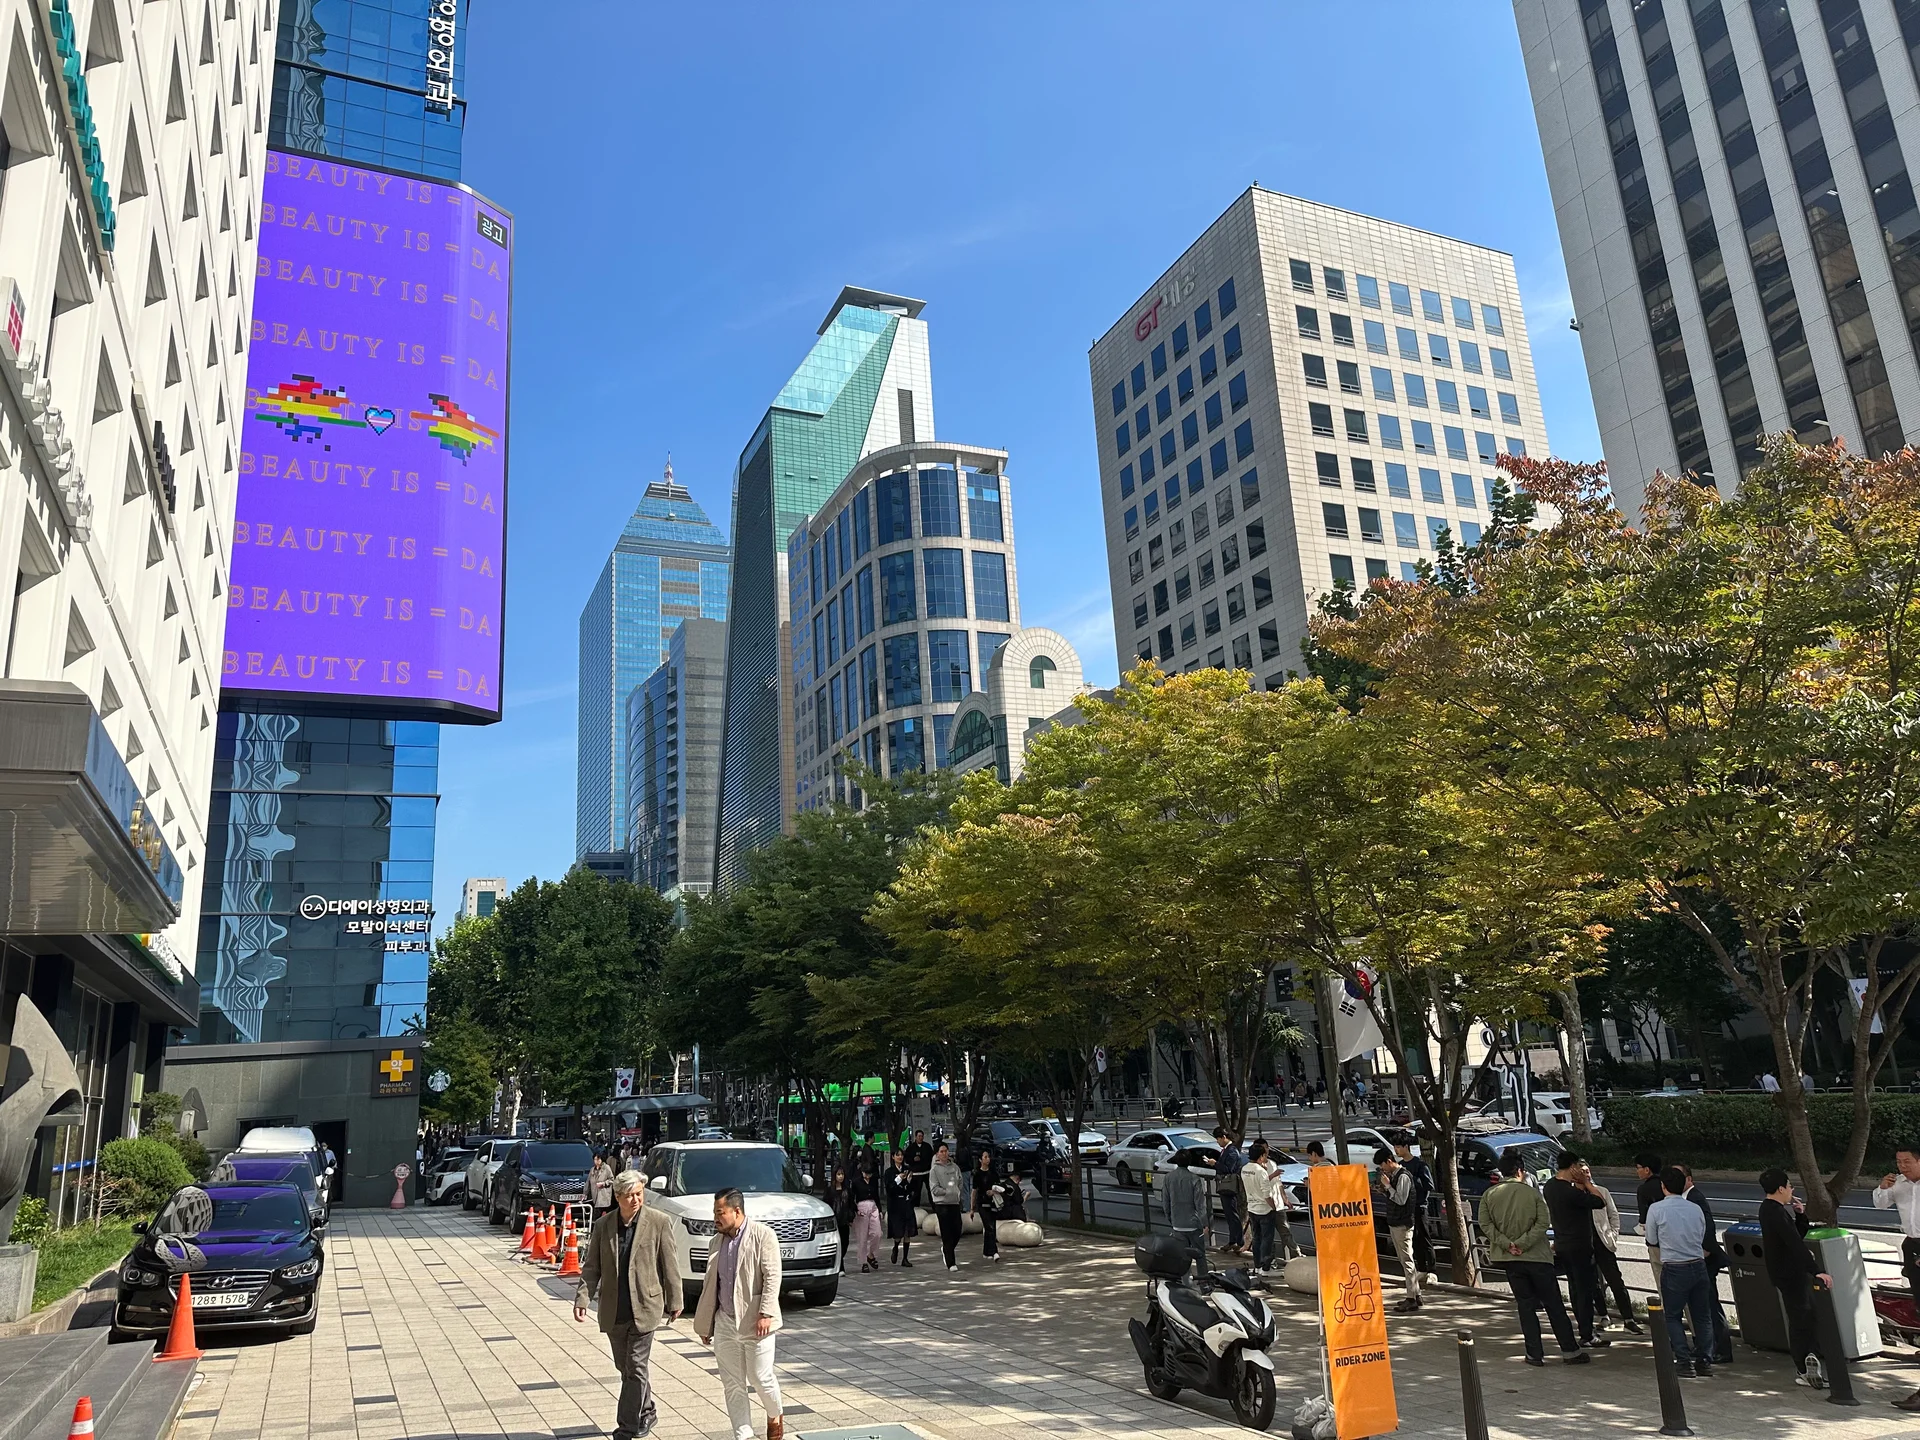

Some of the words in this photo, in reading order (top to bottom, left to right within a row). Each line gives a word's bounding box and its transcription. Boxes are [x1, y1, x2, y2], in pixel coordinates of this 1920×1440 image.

[266, 153, 392, 195] BEAUTY
[406, 181, 432, 204] IS
[260, 202, 389, 244] BEAUTY
[403, 229, 430, 253] IS
[471, 247, 503, 282] DA
[482, 217, 503, 244] 광고
[256, 256, 387, 297] BEAUTY
[400, 281, 428, 304] IS
[469, 298, 501, 331] DA
[249, 319, 384, 359] BEAUTY
[398, 342, 425, 366] IS
[467, 358, 499, 391] DA
[394, 409, 422, 431] IS
[238, 452, 376, 488] BEAUTY
[391, 470, 419, 494] IS
[463, 482, 496, 515] DA
[233, 521, 373, 555] BEAUTY
[388, 536, 416, 560] IS
[461, 547, 494, 578] DA
[228, 584, 369, 617] BEAUTY
[384, 598, 414, 621] IS
[459, 607, 493, 637] DA
[222, 650, 366, 681] BEAUTY
[380, 660, 411, 684] IS
[457, 668, 490, 697] DA
[329, 899, 430, 915] 디에이성형외과
[346, 920, 429, 934] 모발이식센터
[385, 940, 427, 953] 피부과
[391, 1060, 403, 1072] 약
[1320, 1222, 1345, 1230] FOODCOURT
[220, 1294, 245, 1304] 1578
[1335, 1355, 1361, 1368] RIDER
[1361, 1351, 1386, 1363] ZONE
